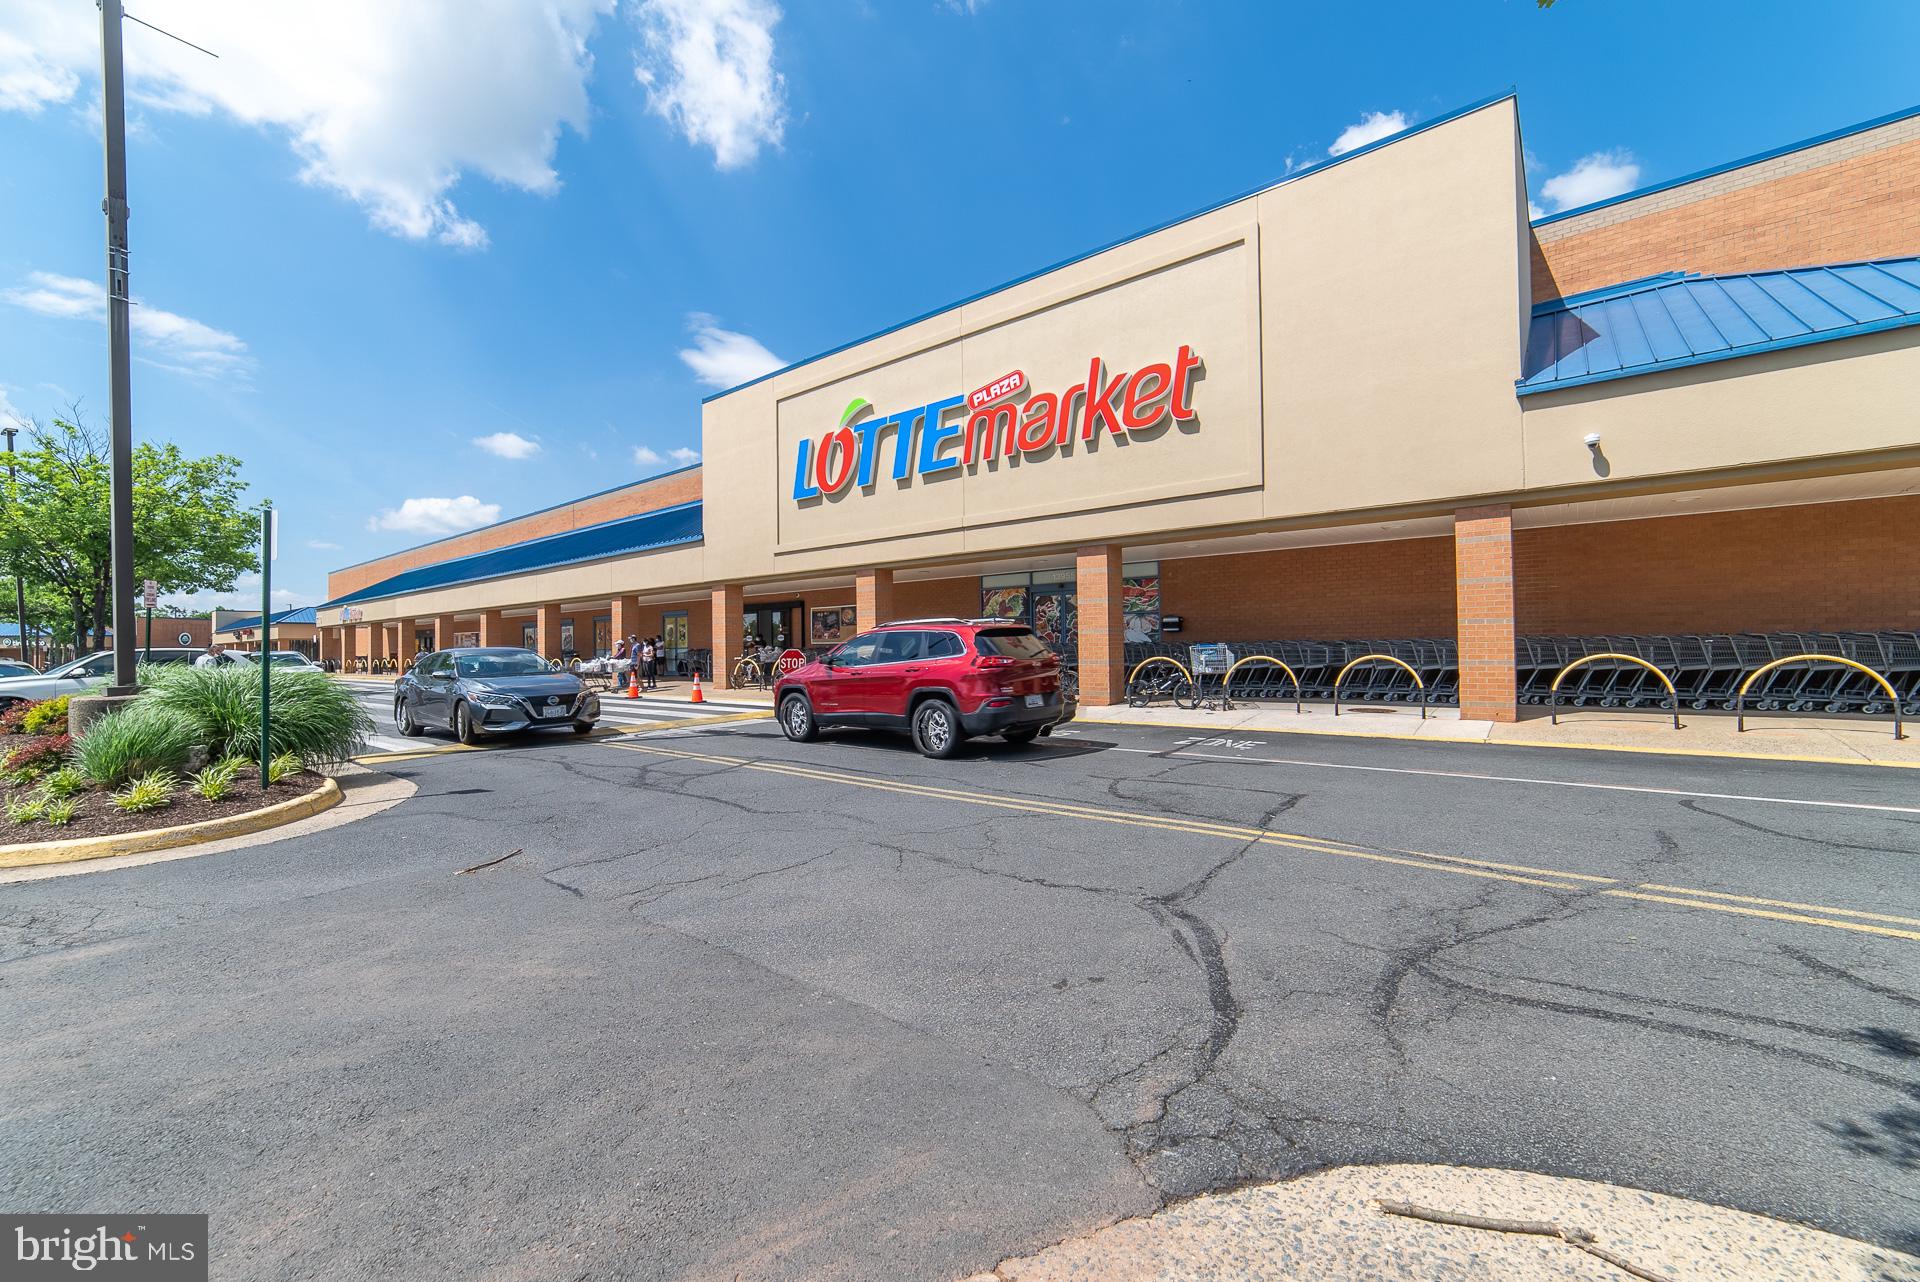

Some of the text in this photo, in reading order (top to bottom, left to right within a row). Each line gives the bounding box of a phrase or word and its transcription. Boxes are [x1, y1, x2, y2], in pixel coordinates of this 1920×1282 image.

[972, 373, 1020, 407] PLAZA
[792, 345, 1200, 501] LOTTE market
[780, 658, 804, 669] STOP
[1173, 736, 1267, 750] ZONE
